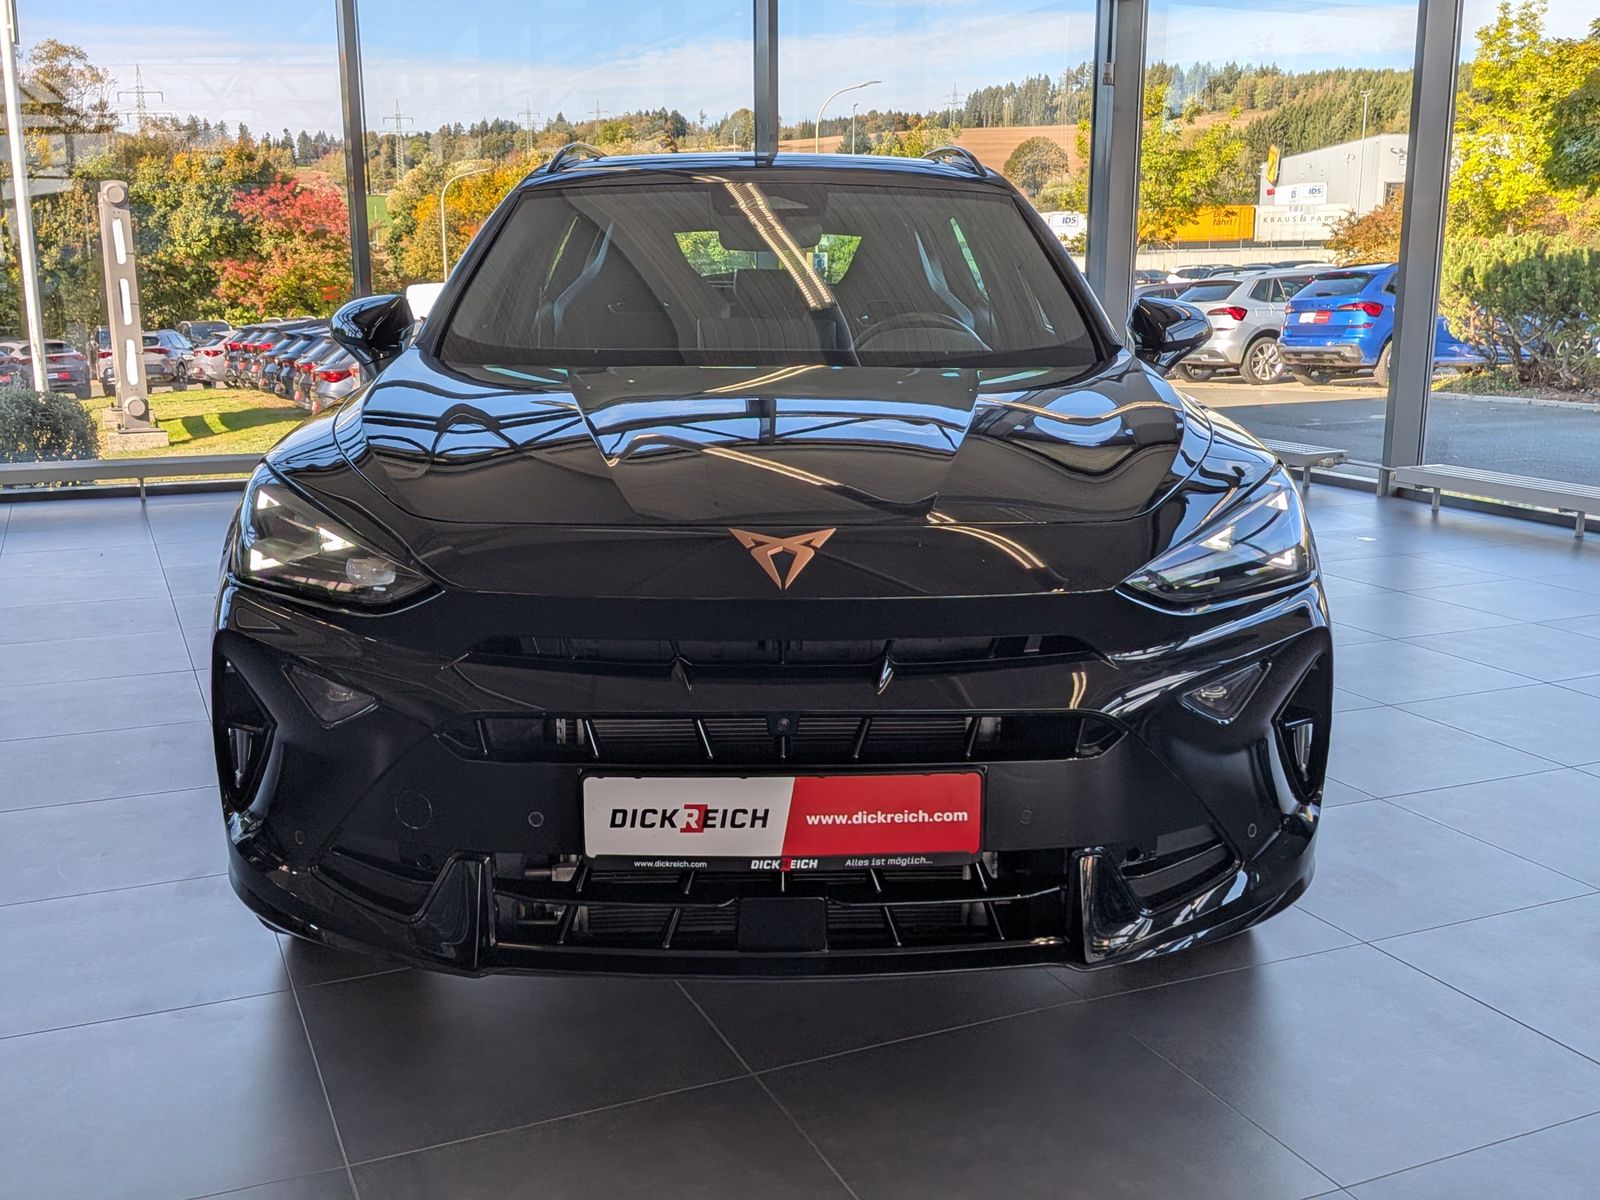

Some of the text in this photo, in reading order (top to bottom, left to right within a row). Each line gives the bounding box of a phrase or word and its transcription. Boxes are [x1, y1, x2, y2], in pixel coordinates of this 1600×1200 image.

[1062, 216, 1077, 224] IDS
[1299, 214, 1307, 222] &
[609, 806, 770, 831] DICKREICH
[806, 810, 968, 825] www.dickreich.com
[633, 859, 708, 869] www.dickreich.com
[844, 856, 933, 867] Alles ist möglich...
